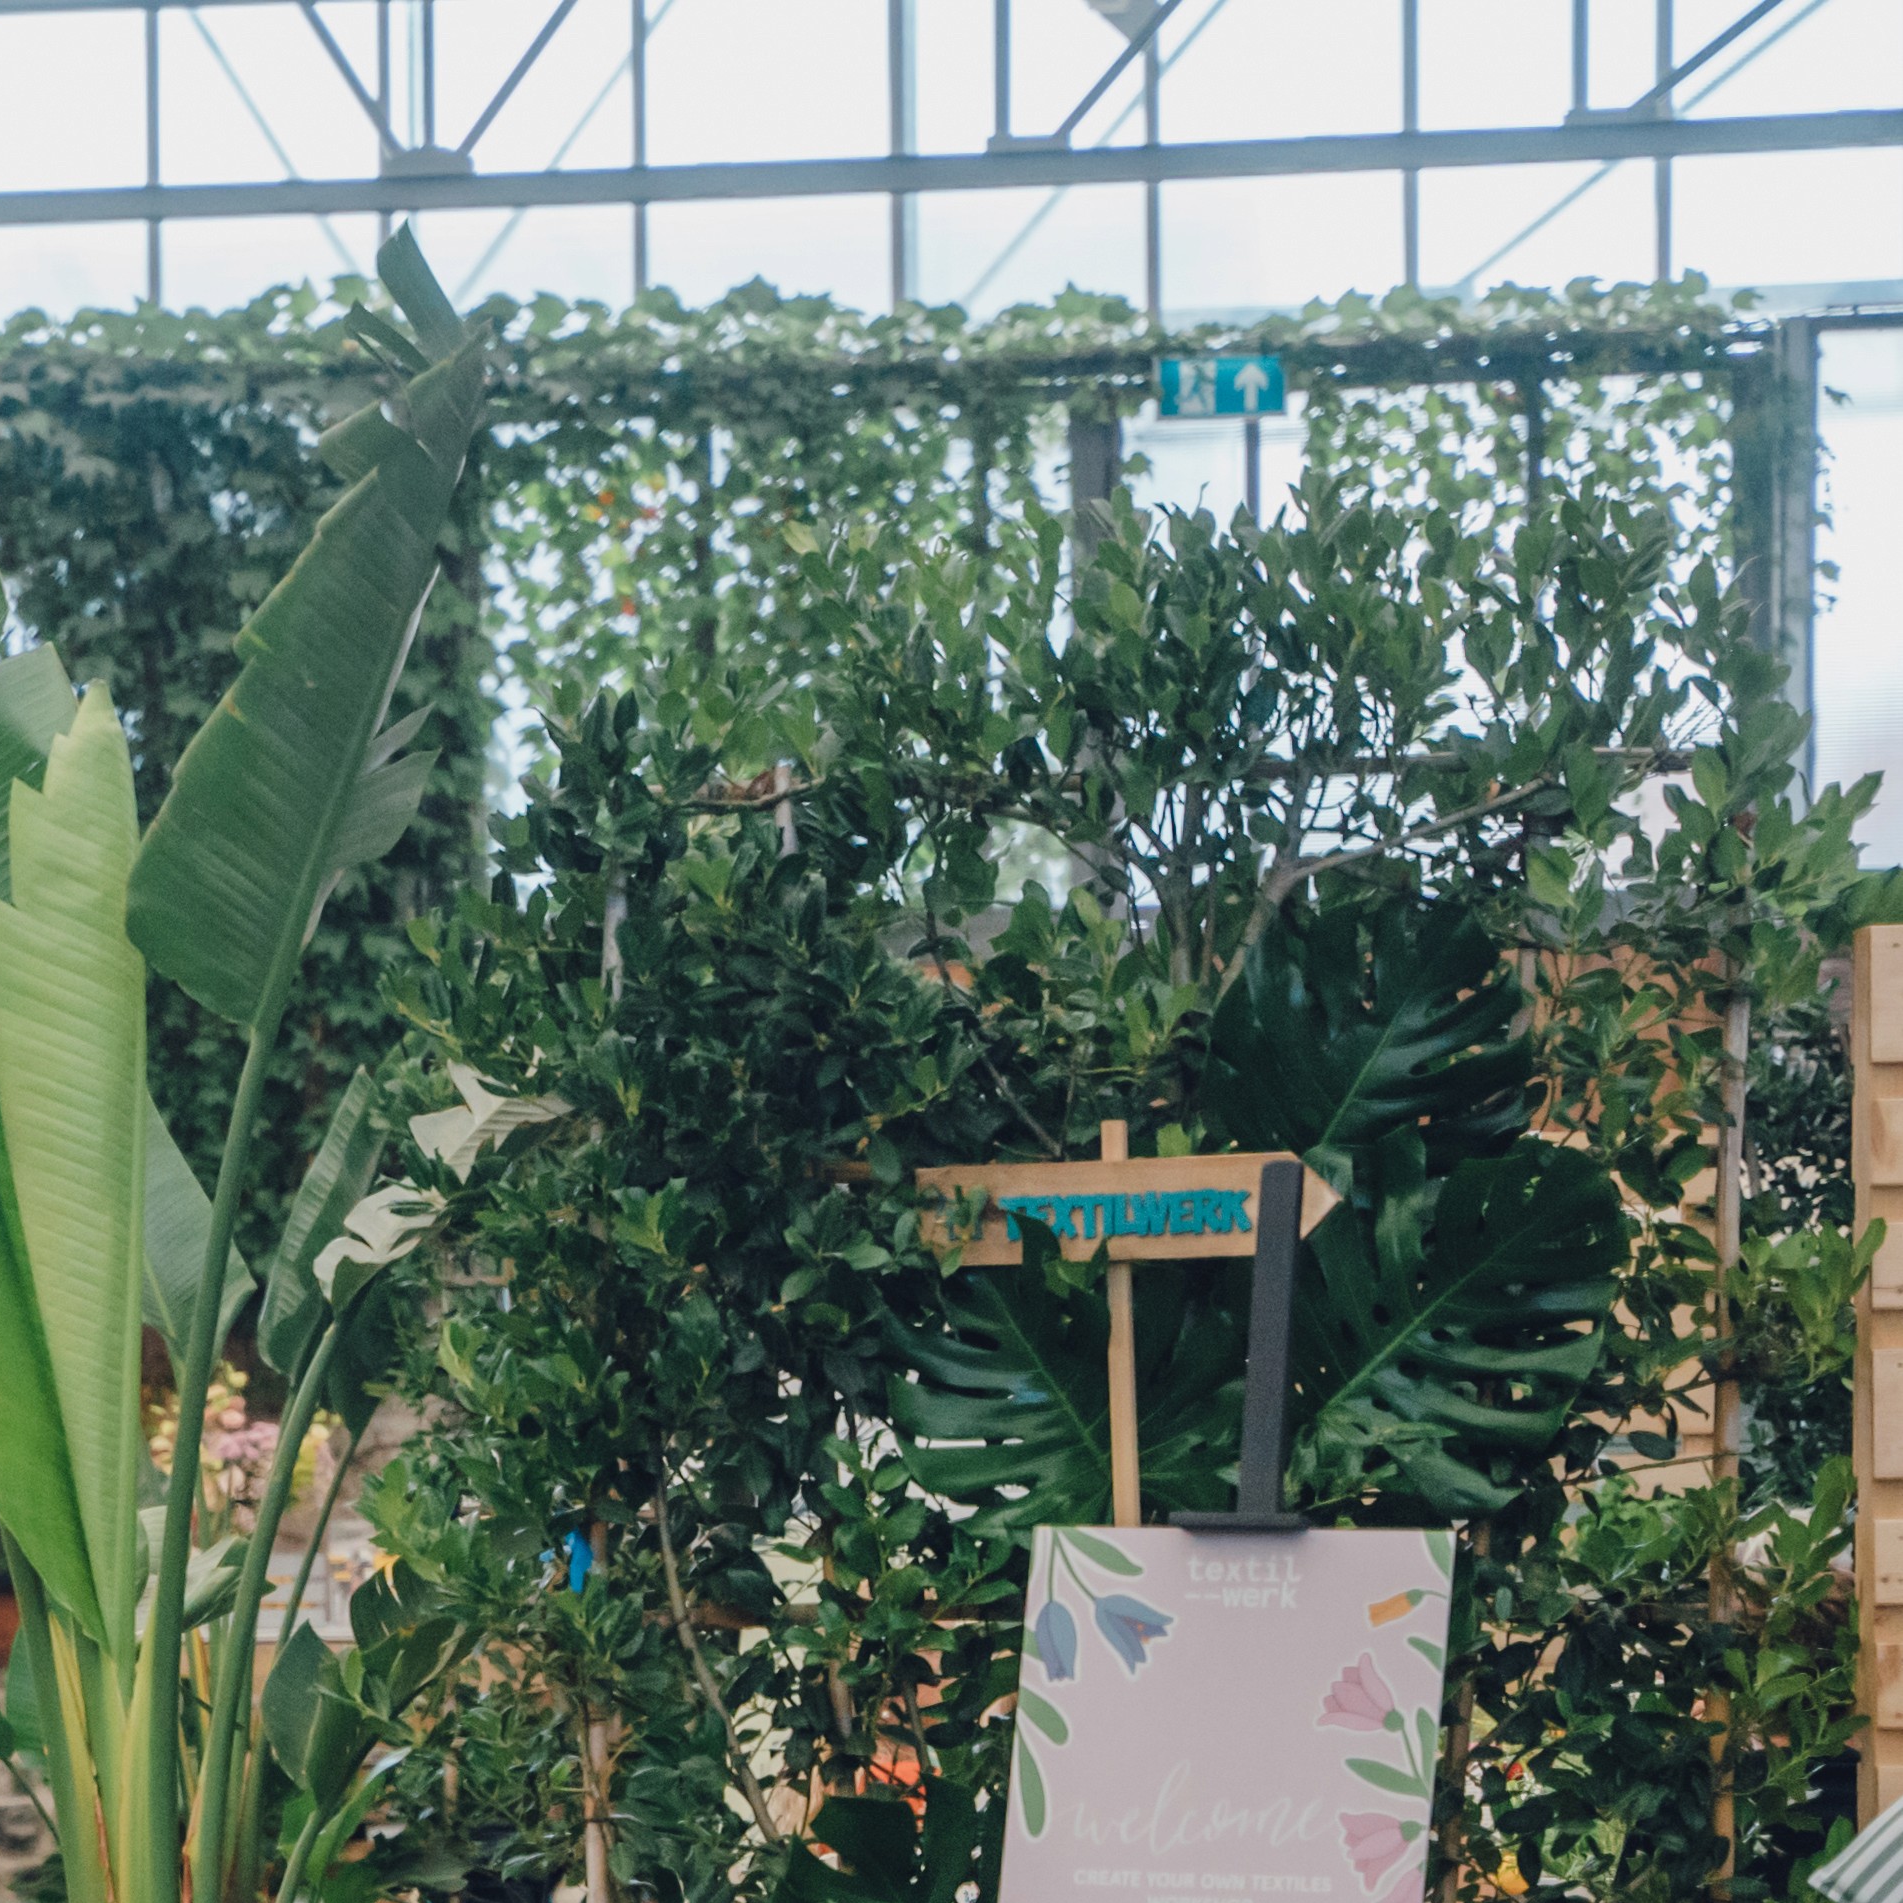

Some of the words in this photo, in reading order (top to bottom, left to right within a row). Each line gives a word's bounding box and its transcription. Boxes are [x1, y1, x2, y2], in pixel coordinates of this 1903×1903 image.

[998, 1188, 1252, 1242] TEXTILWERK
[1188, 1555, 1301, 1583] textil
[1073, 1867, 1141, 1888] CREATE
[1145, 1870, 1195, 1890] YOUR
[1200, 1872, 1245, 1891] OWN
[1251, 1873, 1332, 1894] TEXTILES
